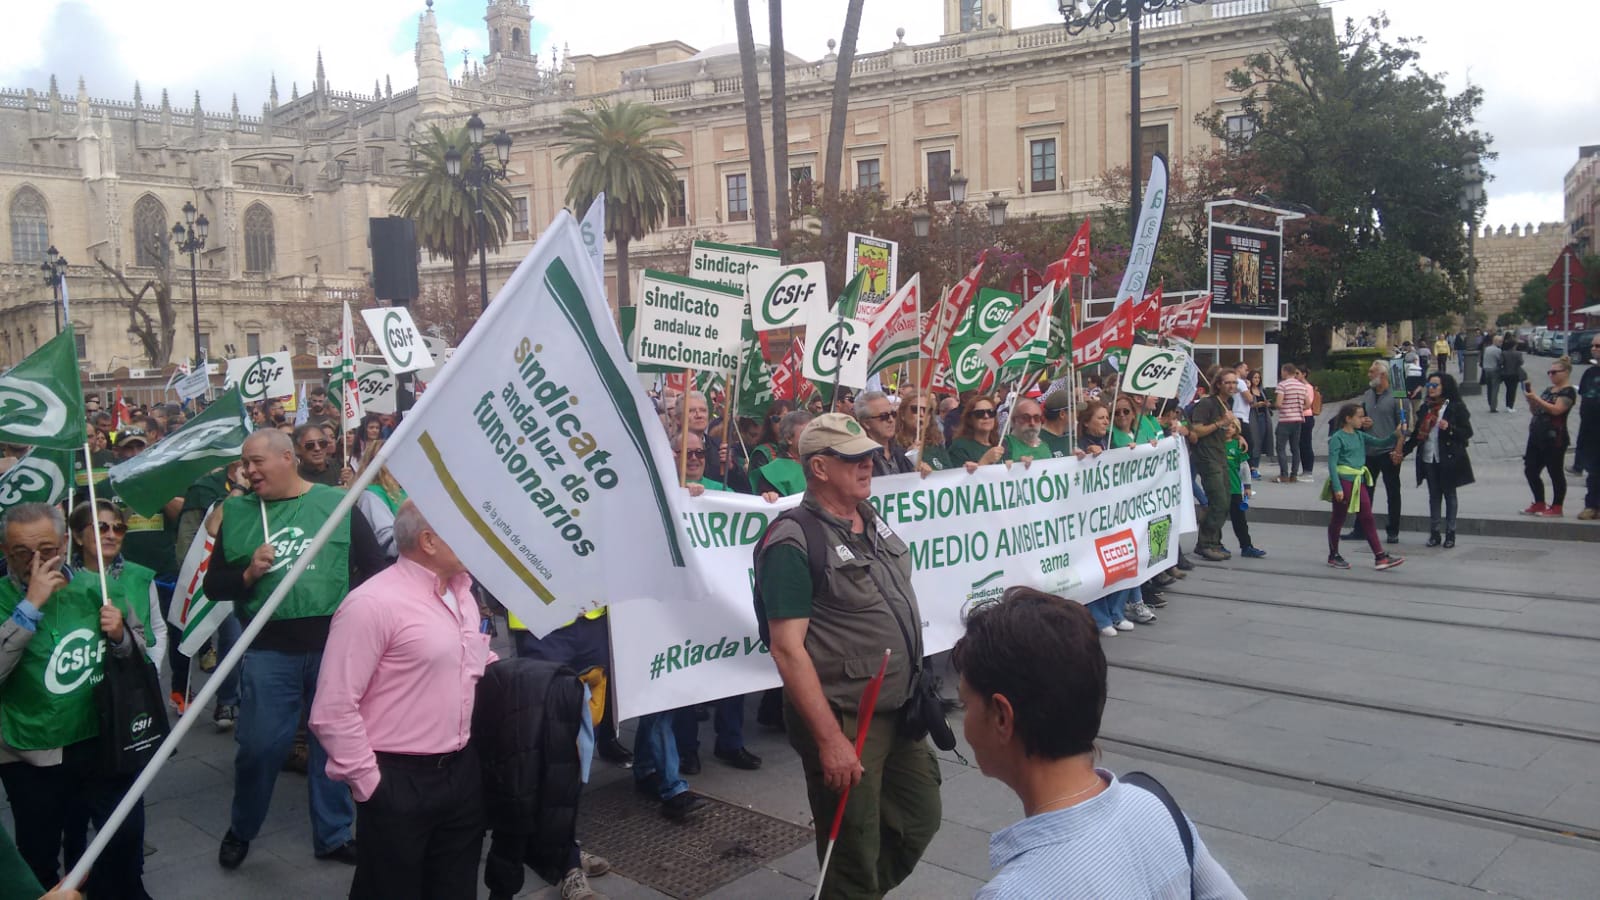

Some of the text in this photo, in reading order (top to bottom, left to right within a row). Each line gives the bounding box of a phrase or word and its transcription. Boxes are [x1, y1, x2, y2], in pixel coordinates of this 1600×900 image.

[644, 285, 719, 318] sindicato
[654, 317, 719, 340] andaluz de
[641, 336, 738, 371] funcionarios
[514, 336, 618, 490] sindicato
[502, 381, 590, 504] andaluz de
[472, 390, 596, 557] funcionarios
[1112, 455, 1159, 487] EMPLEO
[482, 501, 492, 513] de
[493, 517, 513, 536] junta
[510, 534, 521, 546] de
[910, 531, 989, 571] MEDIO
[995, 513, 1076, 558] AMBIENTE
[1078, 510, 1087, 534] Y
[1090, 491, 1157, 534] CELADORES
[1040, 553, 1070, 574] aama
